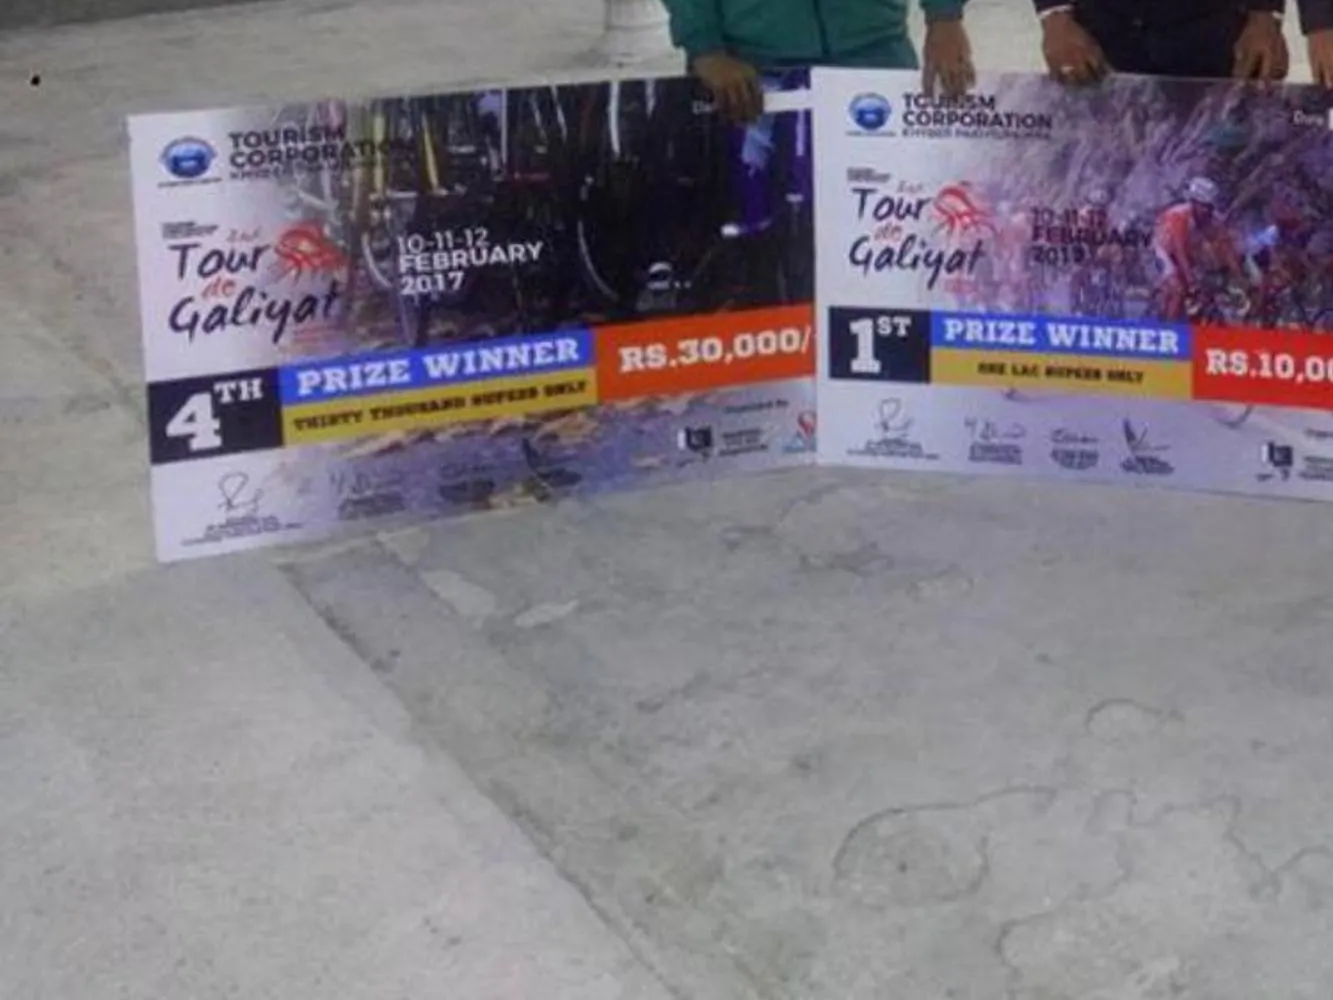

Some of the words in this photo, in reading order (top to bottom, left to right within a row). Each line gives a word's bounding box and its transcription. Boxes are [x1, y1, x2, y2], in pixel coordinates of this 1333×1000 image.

[229, 125, 345, 149] TOURISM
[902, 110, 1052, 129] CORPORATION
[851, 187, 934, 221] Tour
[398, 228, 490, 255] 10-11-12
[399, 243, 543, 273] FEBRUARY
[168, 243, 272, 280] Tour
[849, 233, 987, 291] Galiyat
[401, 271, 464, 296] 2017
[168, 280, 342, 345] Galiyat
[850, 315, 912, 375] 1ST
[944, 317, 1036, 345] PRIZE
[1047, 326, 1179, 355] WINNER
[297, 358, 412, 397] PRIZE
[422, 337, 580, 379] WINNER
[165, 376, 264, 452] 4TH
[294, 409, 363, 432] THIRTY
[369, 397, 466, 421] THOUSAND
[472, 388, 538, 408] RUPEES
[543, 379, 587, 398] ONLY
